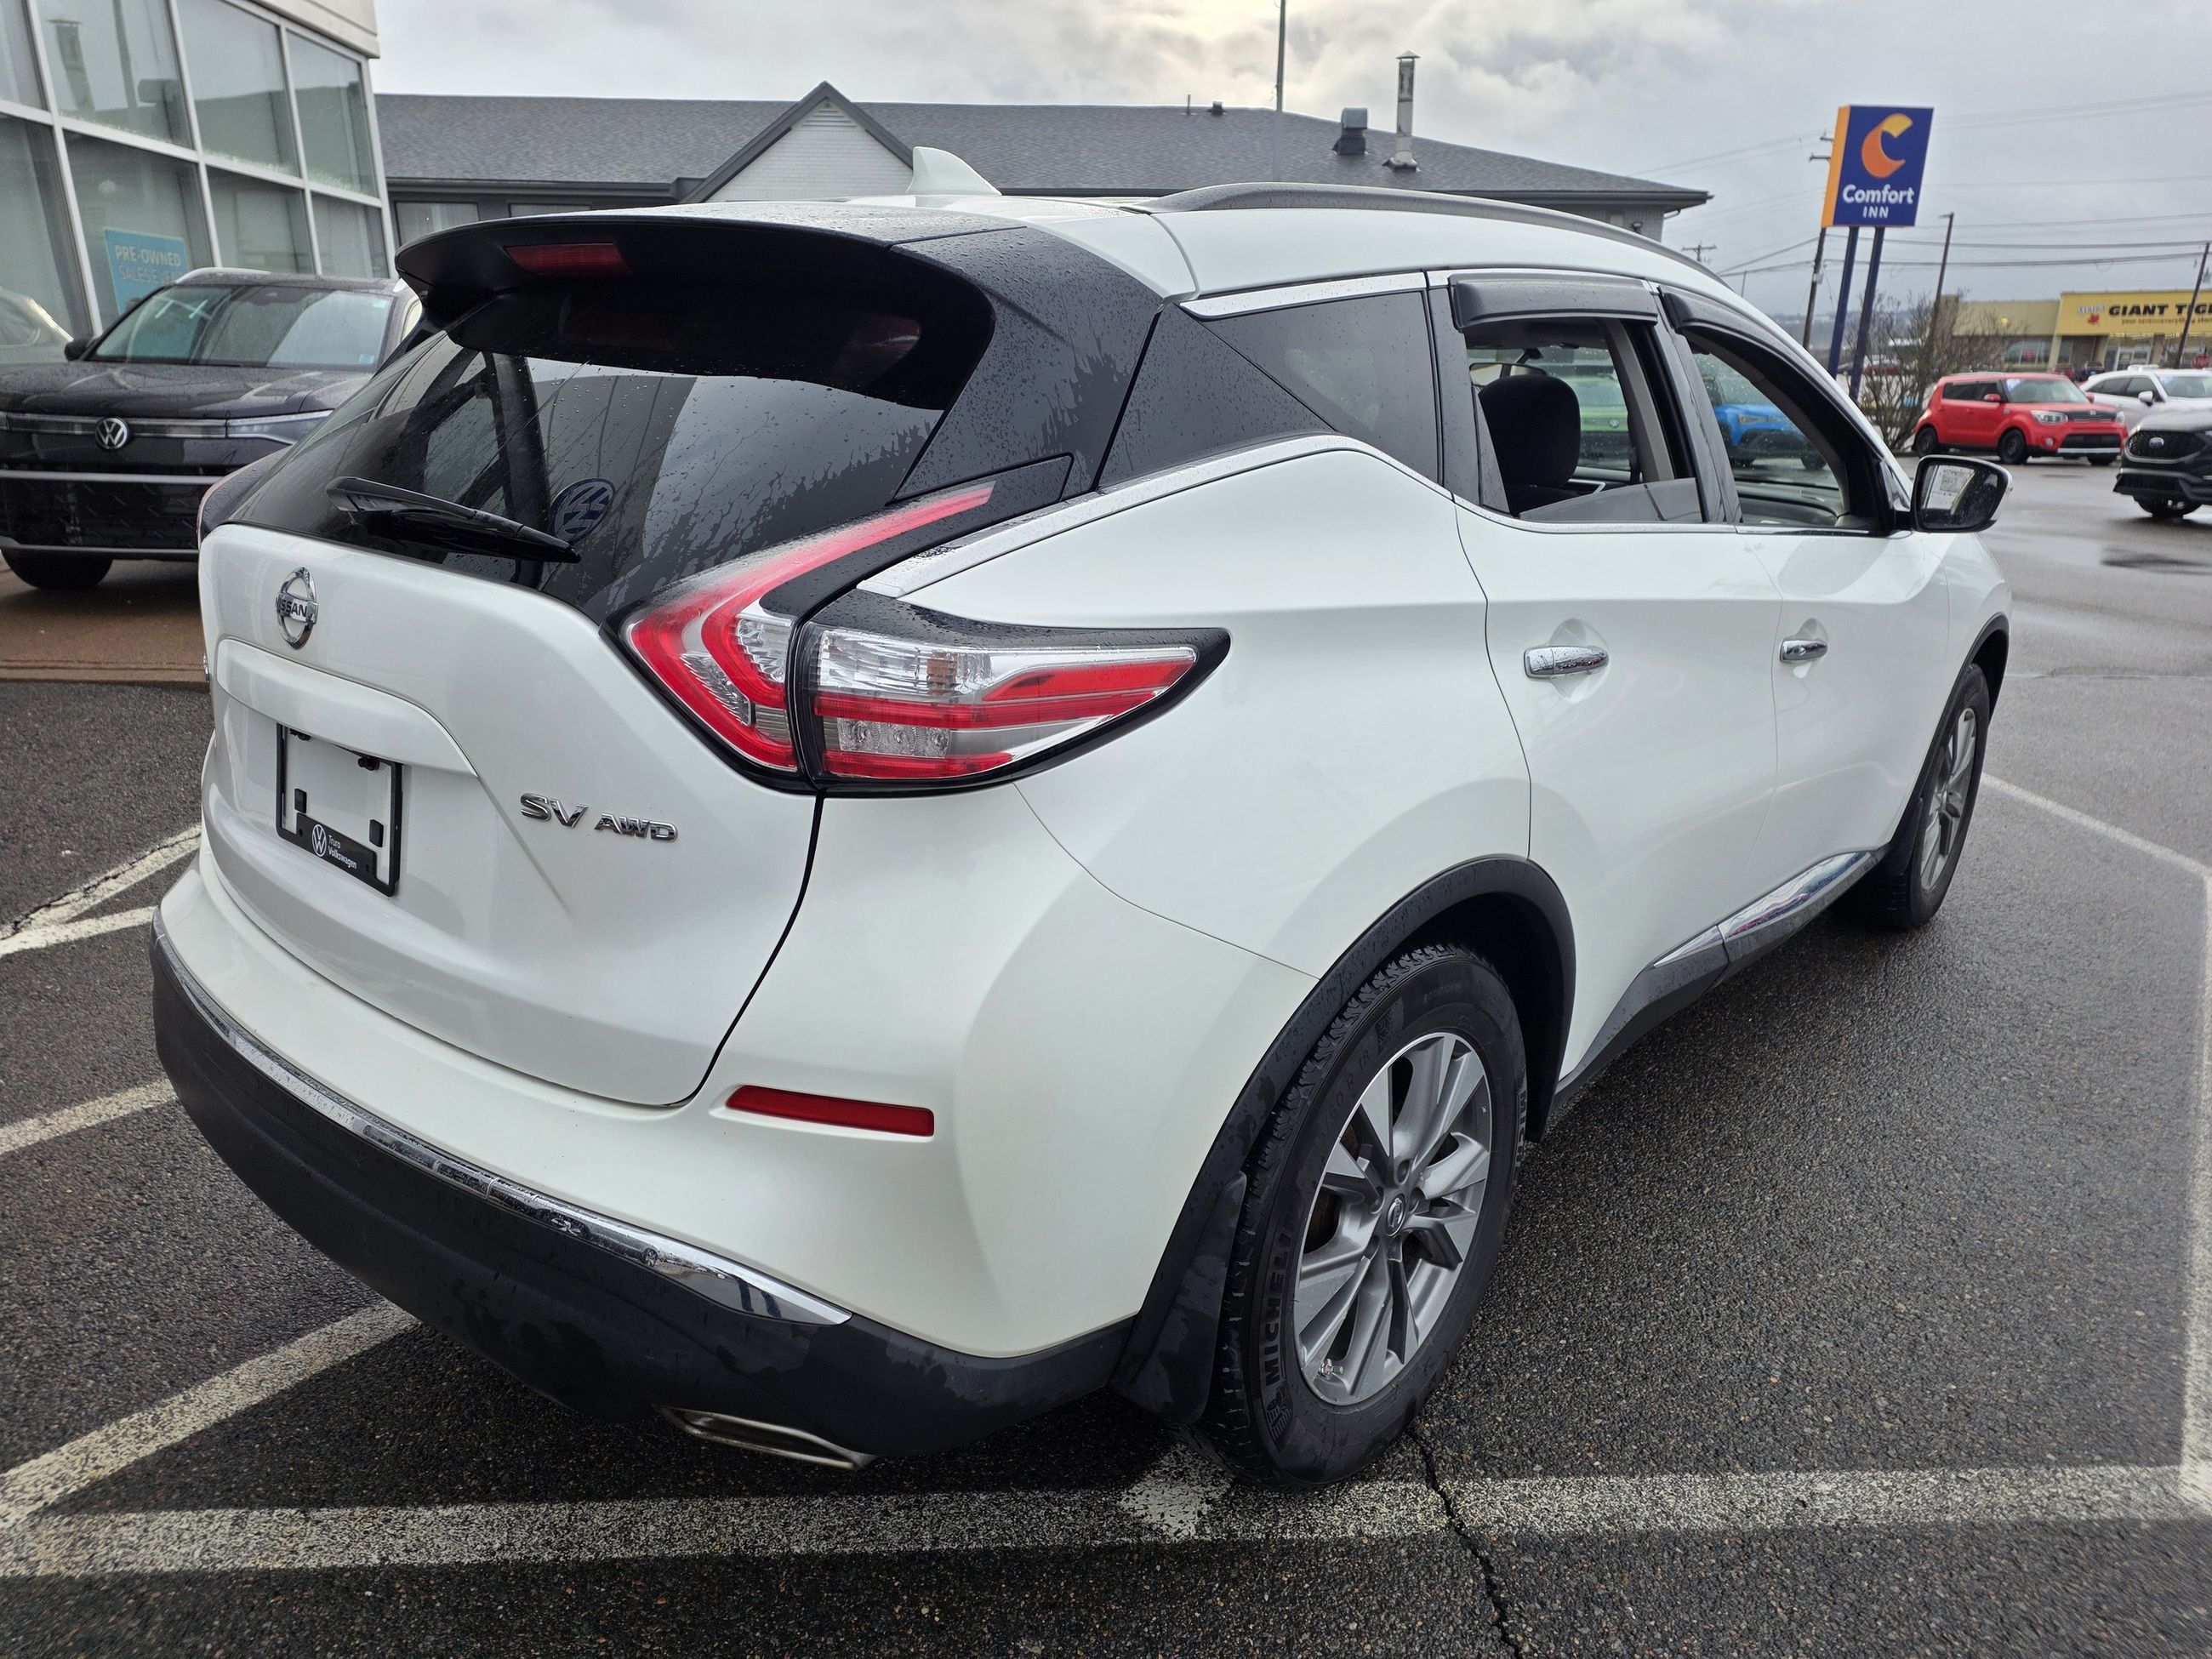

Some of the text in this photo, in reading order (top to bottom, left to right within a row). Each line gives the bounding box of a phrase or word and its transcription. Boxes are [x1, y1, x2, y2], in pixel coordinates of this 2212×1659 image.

[1842, 184, 1915, 204] Comfort
[1862, 206, 1890, 219] INN
[115, 245, 181, 267] PRE-OWNED
[2108, 304, 2169, 316] GIANT
[521, 792, 678, 843] SV AWD
[328, 846, 357, 869] Volkswagen
